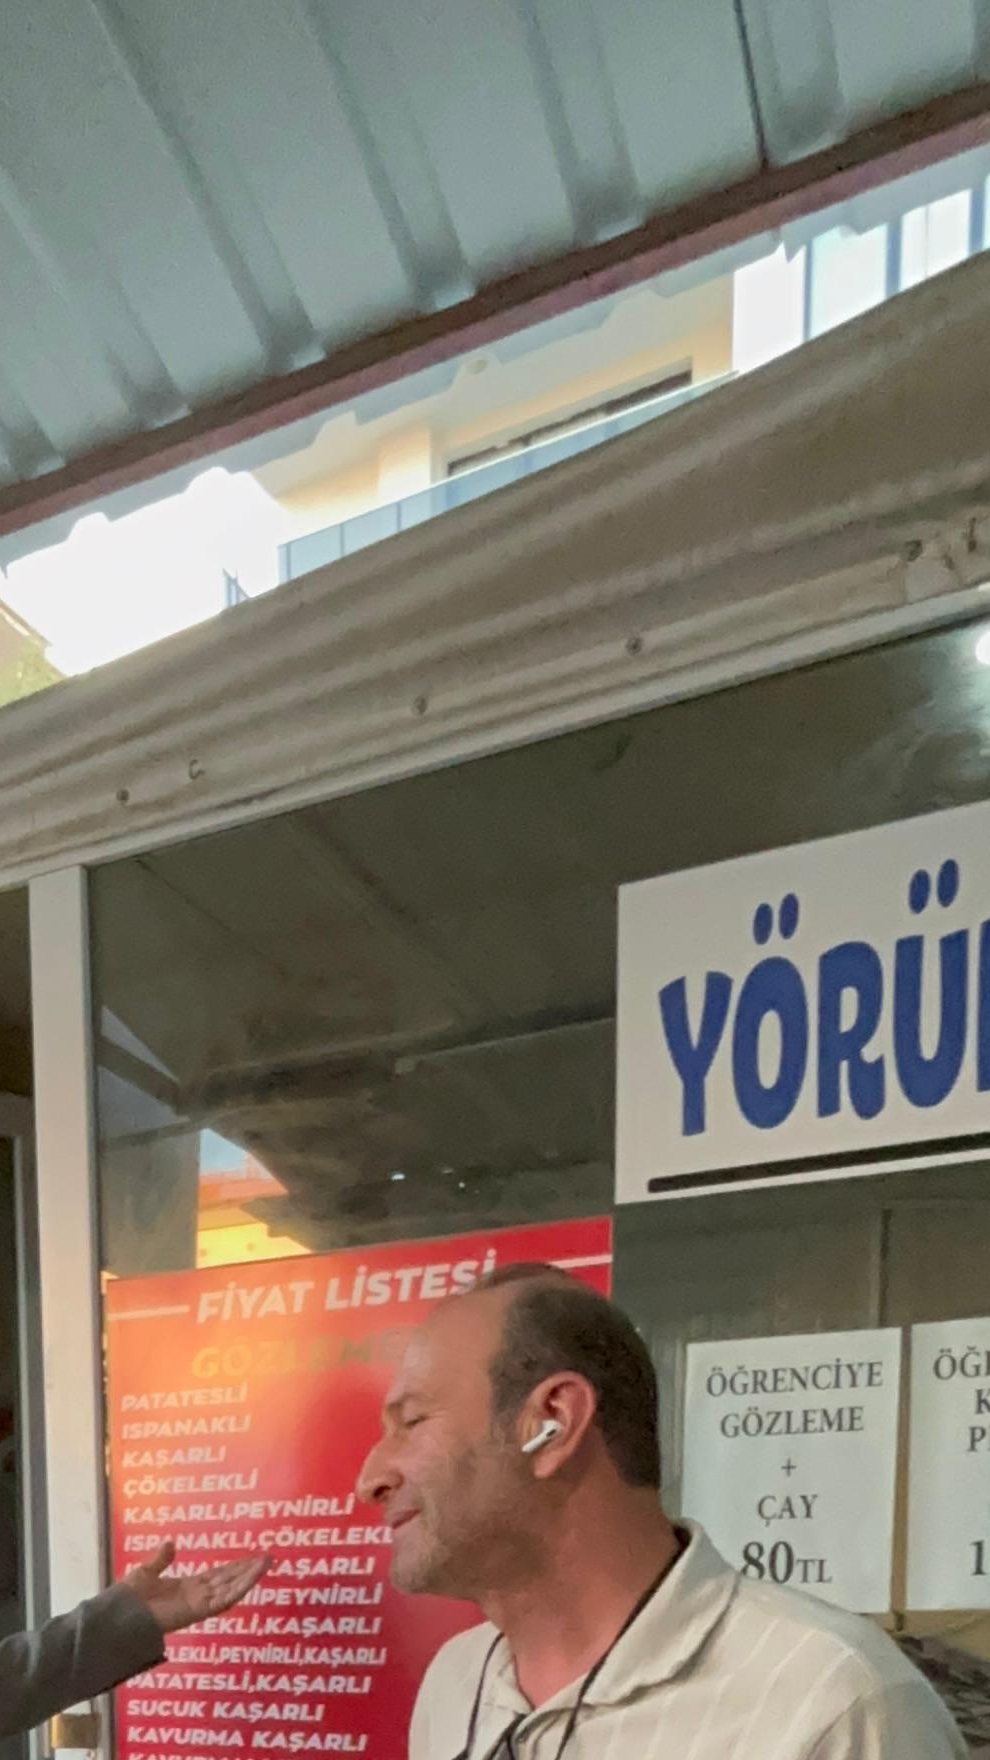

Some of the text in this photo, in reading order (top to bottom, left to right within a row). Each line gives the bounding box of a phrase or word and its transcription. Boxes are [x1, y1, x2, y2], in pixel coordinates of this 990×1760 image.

[658, 859, 990, 1137] YÖRÜ
[196, 1248, 497, 1324] FİYAT LİSTESİ
[706, 1358, 884, 1398] ÖĞRENCİYE
[120, 1380, 248, 1412] PATATESLİ
[121, 1414, 252, 1440] ISPANAKLI
[720, 1406, 865, 1438] GÖZLEME
[121, 1445, 227, 1470] KAŞARLI
[122, 1467, 259, 1500] ÇÖKELEKLİ
[757, 1494, 818, 1527] ÇAY
[123, 1525, 394, 1552] ISPANAKLI,ÇÖKELEKL
[740, 1541, 833, 1585] 80TL
[127, 1699, 325, 1723] SUCUK KAŞARLI
[126, 1726, 368, 1753] KAVURMA KAŞARLI
